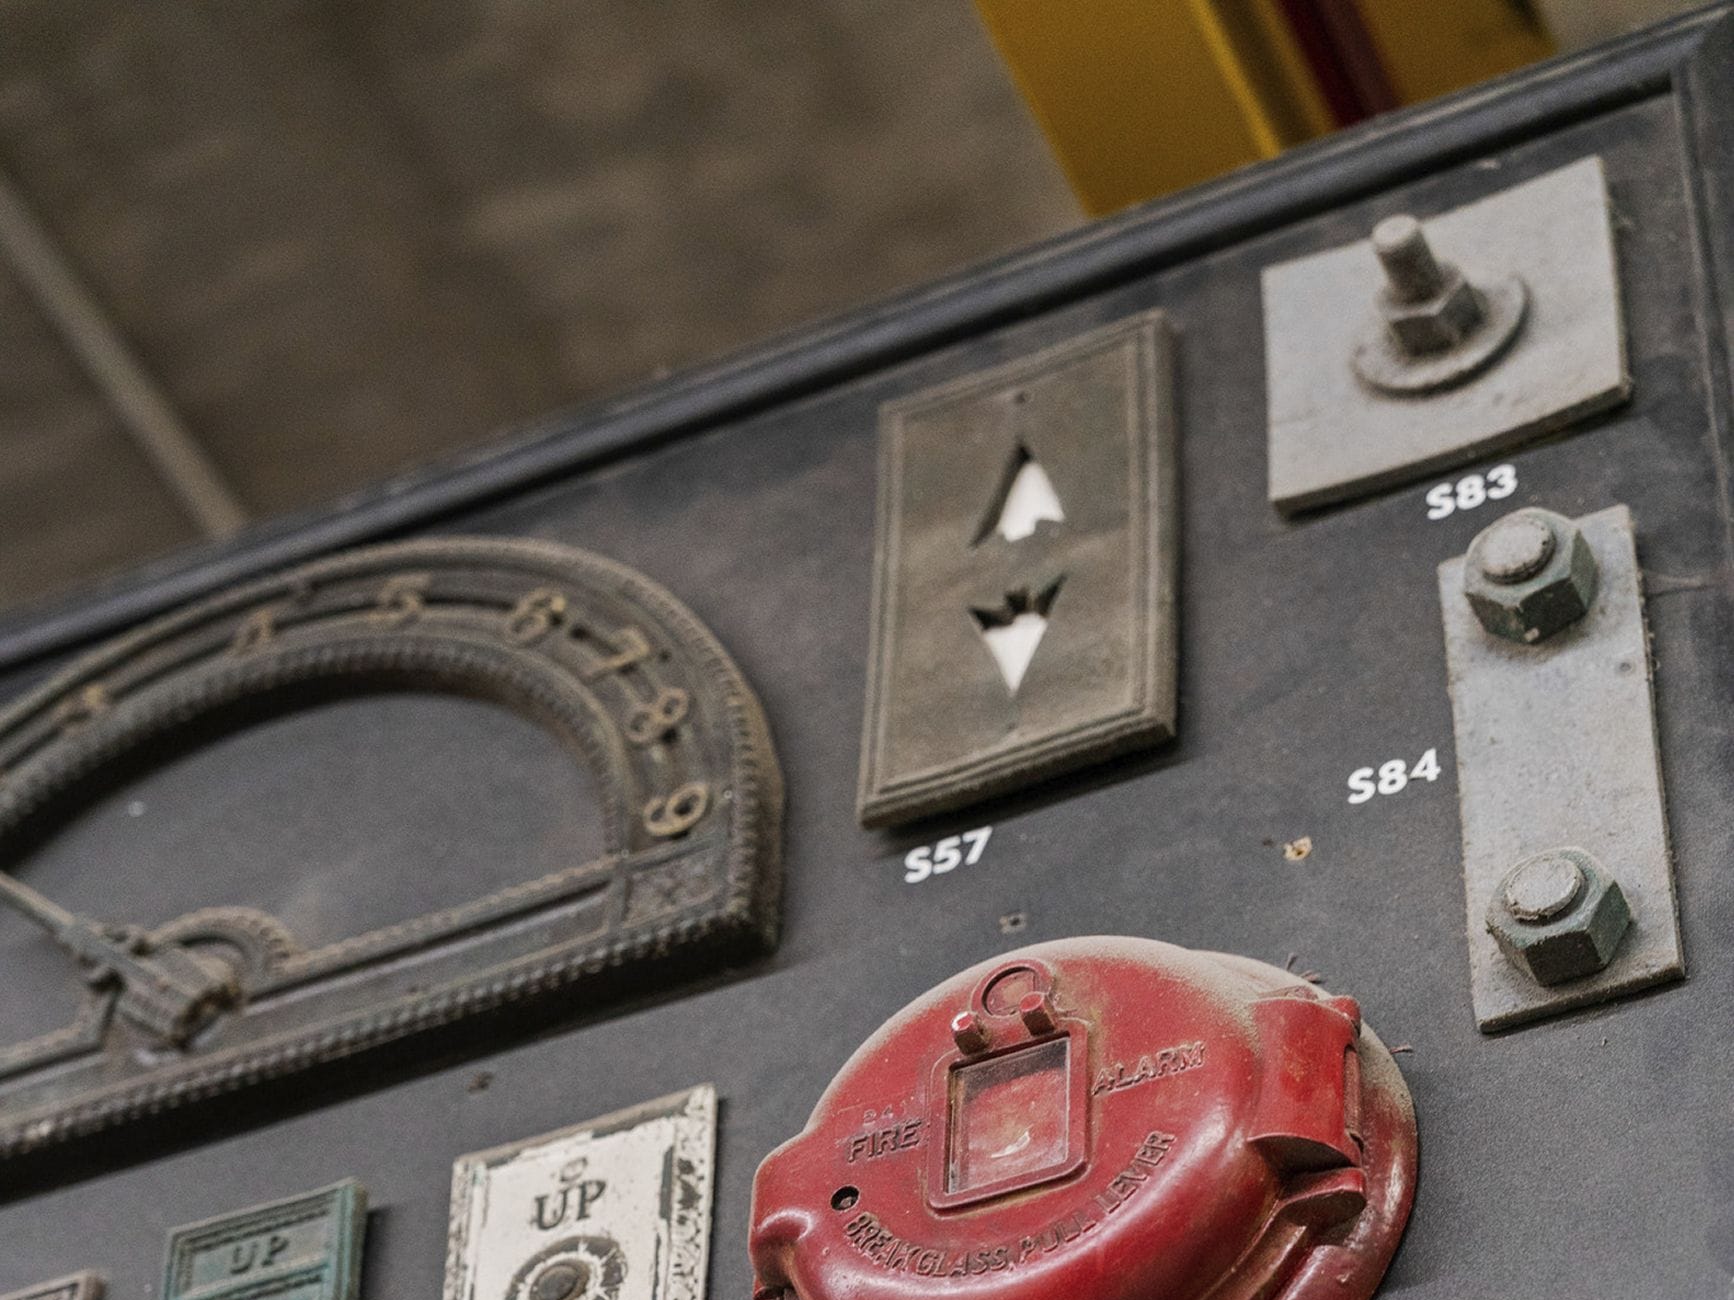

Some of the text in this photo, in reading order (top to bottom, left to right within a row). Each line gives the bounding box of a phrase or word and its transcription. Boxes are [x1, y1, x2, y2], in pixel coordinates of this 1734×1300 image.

[1426, 464, 1518, 520] S83
[509, 585, 567, 646] 6
[583, 625, 651, 677] 7
[623, 688, 689, 743] 8
[1347, 747, 1442, 805] S84
[643, 780, 711, 837] 9
[904, 827, 992, 884] S57
[845, 1040, 1207, 1165] FIRE ALARM
[529, 1178, 607, 1231] UP
[843, 1211, 921, 1273] BREAK
[1018, 1210, 1097, 1266] PULL
[1095, 1130, 1178, 1214] LEVER
[229, 1234, 290, 1275] UP
